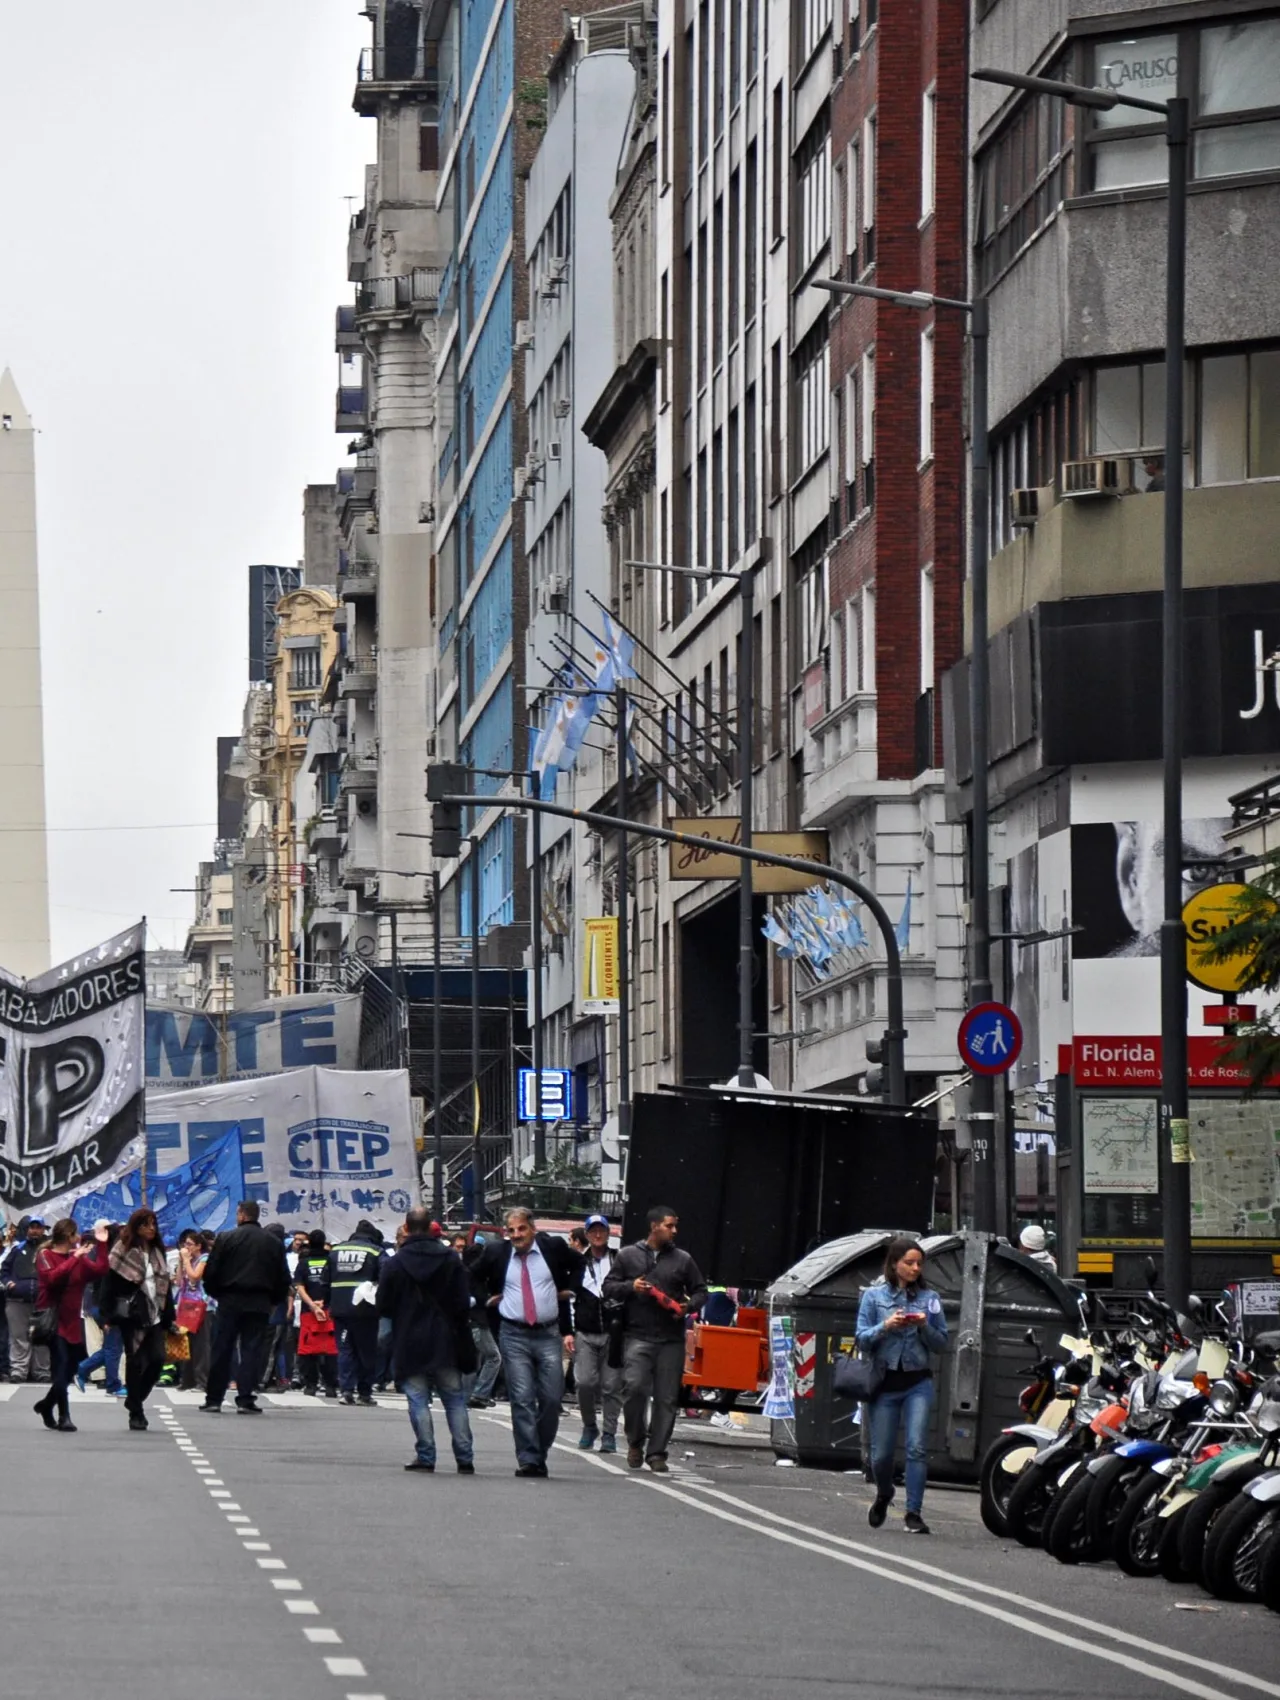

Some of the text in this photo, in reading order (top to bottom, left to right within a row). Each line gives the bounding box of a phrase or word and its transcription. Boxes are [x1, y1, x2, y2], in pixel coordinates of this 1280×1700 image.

[1105, 56, 1178, 88] CARUSO
[1239, 629, 1280, 719] J
[145, 1003, 337, 1079] MTE
[1082, 1044, 1155, 1062] Florida
[1083, 1068, 1091, 1078] a
[1094, 1066, 1104, 1078] L.
[1107, 1066, 1120, 1078] N.
[1123, 1066, 1155, 1078] Alem
[1199, 1066, 1215, 1078] de
[288, 1130, 390, 1170] CTEP
[337, 1250, 368, 1263] MTE
